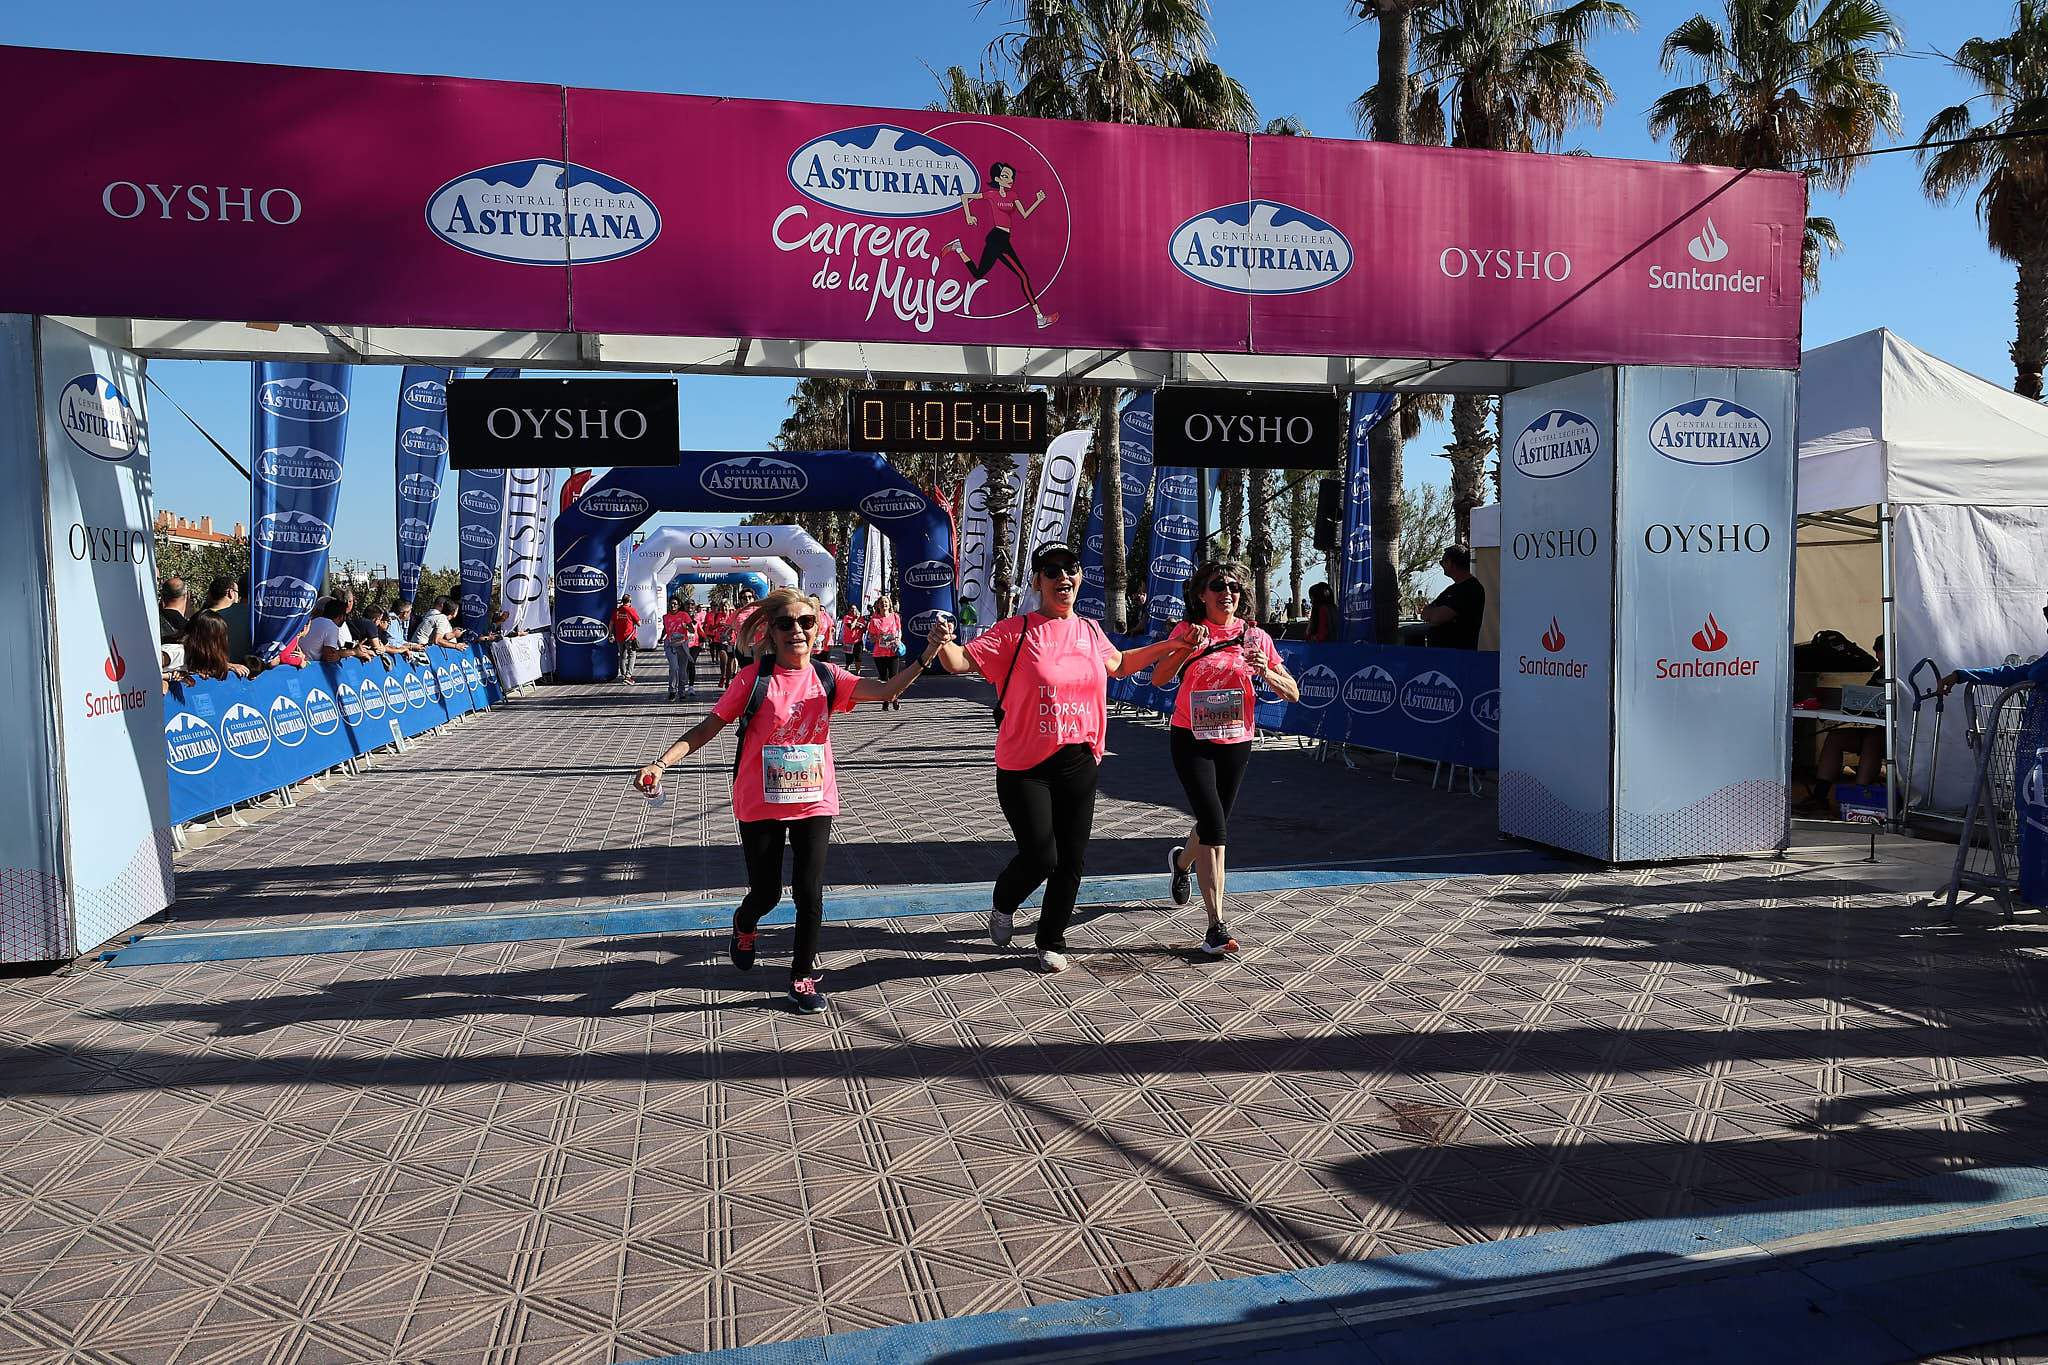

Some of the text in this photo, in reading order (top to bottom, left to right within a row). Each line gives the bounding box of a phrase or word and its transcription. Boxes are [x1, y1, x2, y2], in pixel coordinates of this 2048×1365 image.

[833, 153, 960, 171] CENTRAL LECHERA
[803, 154, 966, 197] ASTURIANA
[102, 181, 302, 225] OYSHO
[481, 193, 555, 206] CENTRAL
[445, 194, 644, 240] ASTURIANA
[771, 206, 931, 259] Carrera
[1212, 231, 1334, 245] CENTRAL LECHERA
[1183, 231, 1340, 272] ASTURIANA
[1439, 247, 1572, 282] OYSHO
[1649, 265, 1765, 294] Santander
[812, 255, 988, 333] de la Mujer
[262, 388, 341, 413] ASTURIANA
[66, 396, 136, 446] ASTURIANA
[486, 407, 648, 441] OYSHO
[863, 400, 1033, 441] 01:06:44
[1184, 413, 1314, 445] OYSHO
[1676, 421, 1759, 429] CENTRAL LECHERA
[1657, 422, 1762, 449] ASTURIANA
[1518, 437, 1592, 467] ASTURIANA
[261, 456, 336, 480] ASTURIANA
[709, 469, 801, 490] ASTURIANA
[583, 499, 643, 512] ASTURIANA
[865, 501, 922, 512] ASTURIANA
[69, 523, 145, 564] OYSHO
[258, 523, 328, 545] ASTURIANA
[689, 532, 773, 549] OYSHO
[1513, 527, 1597, 560] OYSHO
[1644, 523, 1771, 554] OYSHO
[1039, 543, 1069, 557] adidas
[558, 575, 605, 587] ASTURIANA
[558, 626, 606, 638] ASTURIANA
[1519, 656, 1588, 679] Santander
[1656, 657, 1760, 680] Santander
[85, 686, 147, 718] Santander
[1039, 685, 1057, 698] TU
[1346, 682, 1391, 704] ASTURIANA
[1403, 688, 1455, 713] ASTURIANA
[1039, 702, 1091, 716] DORSAL
[226, 726, 270, 749] ASTURIANA
[1039, 719, 1078, 734] SUMA
[167, 738, 218, 764] ASTURIANA
